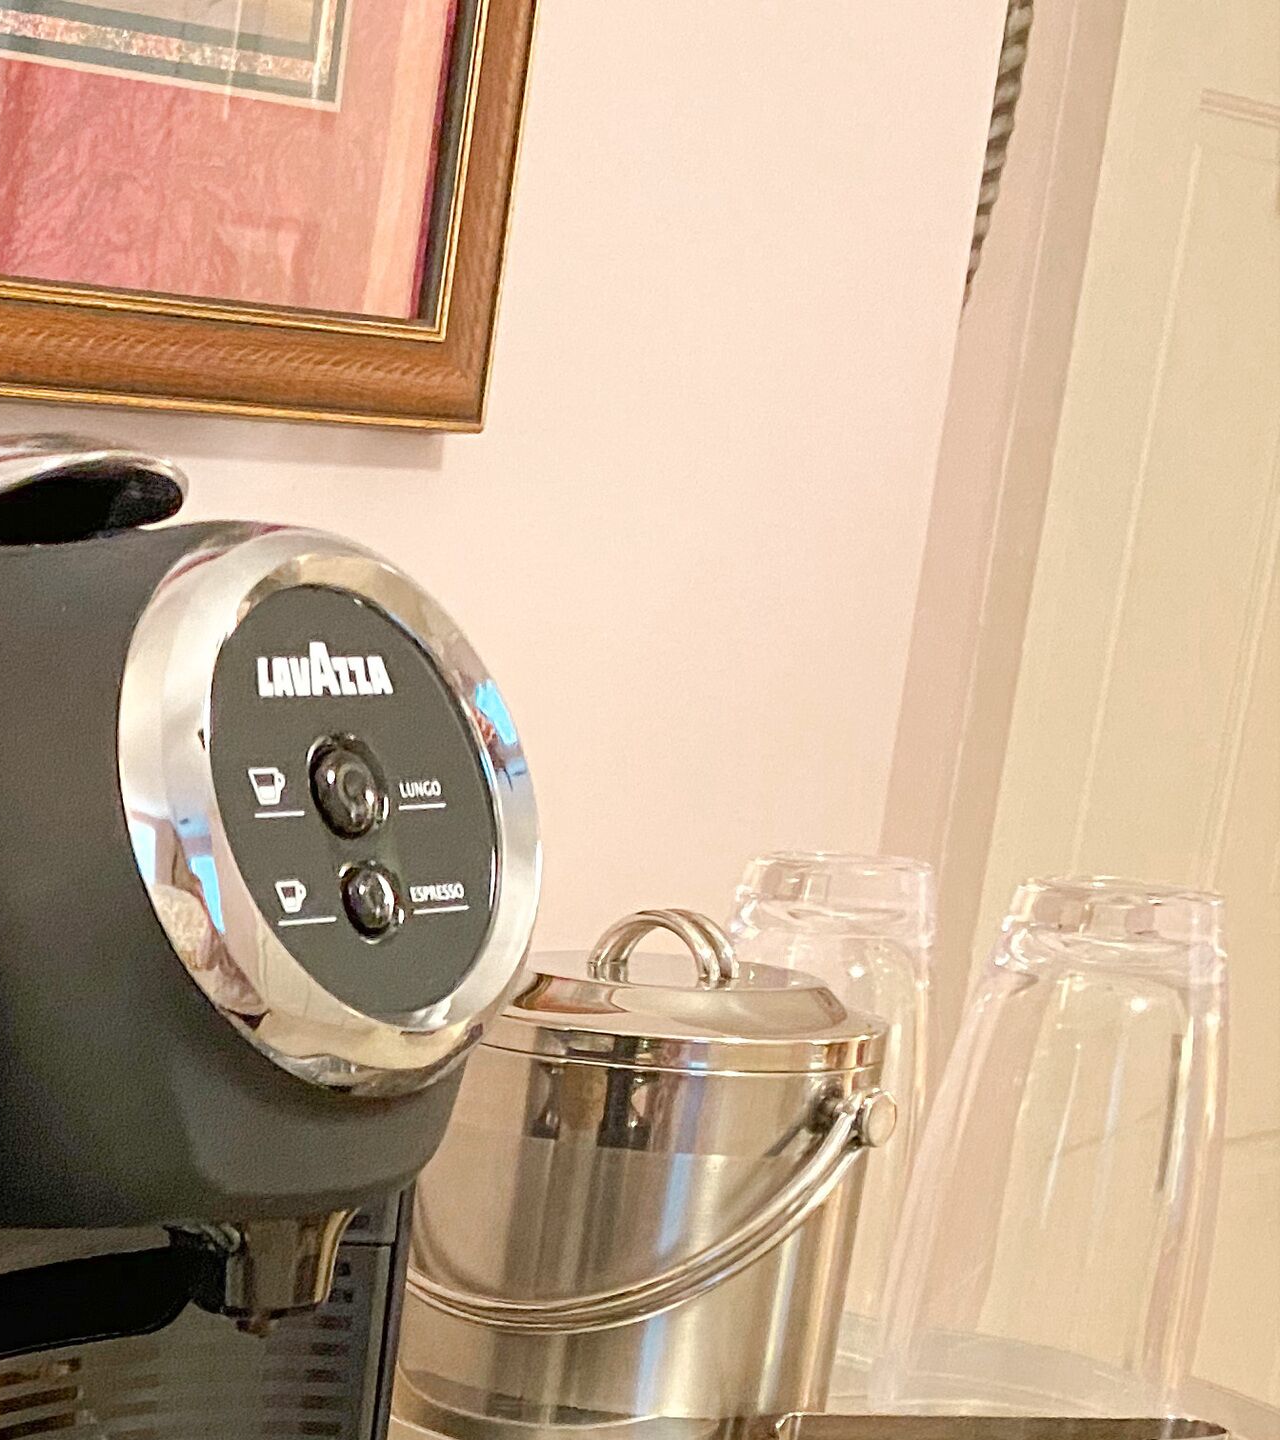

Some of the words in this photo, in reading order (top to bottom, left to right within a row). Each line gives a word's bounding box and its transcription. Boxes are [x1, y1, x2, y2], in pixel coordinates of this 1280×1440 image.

[257, 641, 393, 697] LAVAZZA
[399, 780, 442, 799] LUNGO
[409, 882, 465, 902] ESPRESSO
